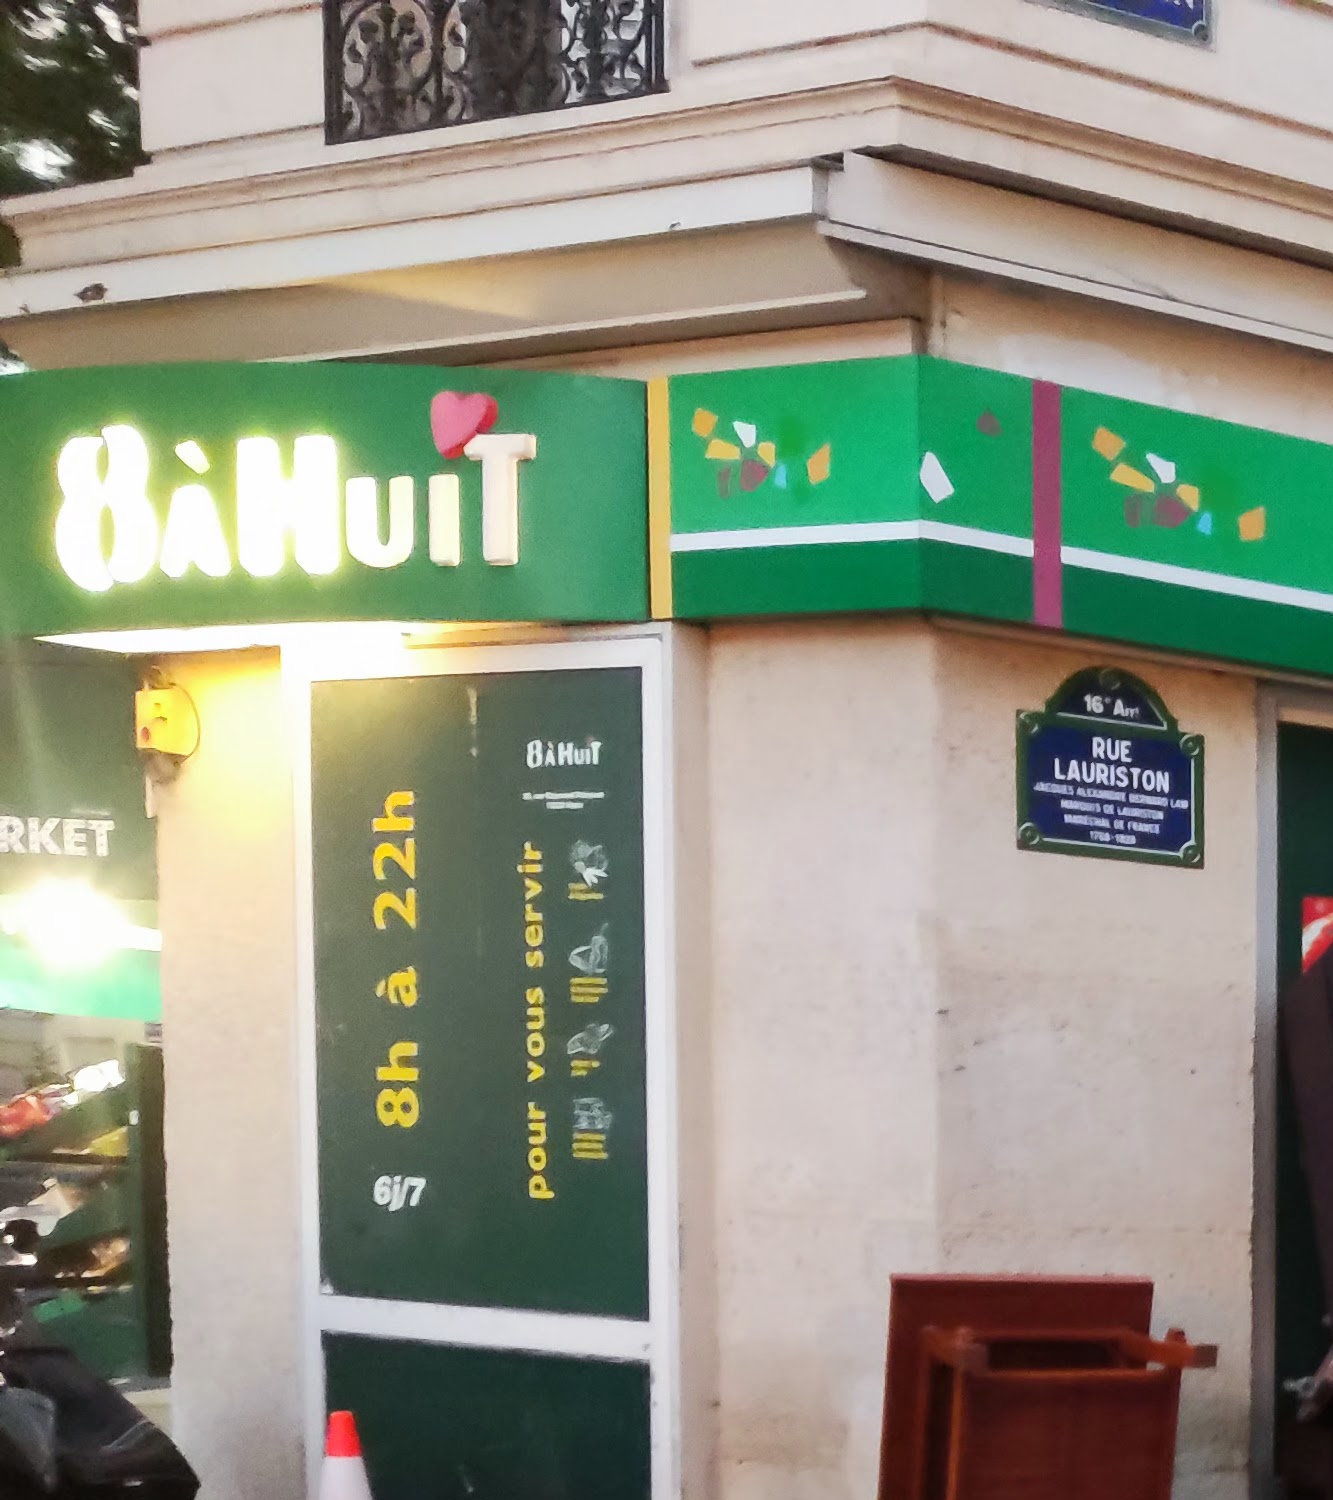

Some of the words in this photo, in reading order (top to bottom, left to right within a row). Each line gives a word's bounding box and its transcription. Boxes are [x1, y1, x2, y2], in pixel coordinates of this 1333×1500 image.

[1053, 757, 1170, 794] LAURISTON
[1092, 737, 1133, 764] RUE
[372, 790, 418, 930] 22h
[516, 841, 545, 969] servir
[376, 965, 418, 1008] à
[525, 987, 546, 1082] vous
[375, 1041, 420, 1129] 8h
[527, 1101, 555, 1199] pour
